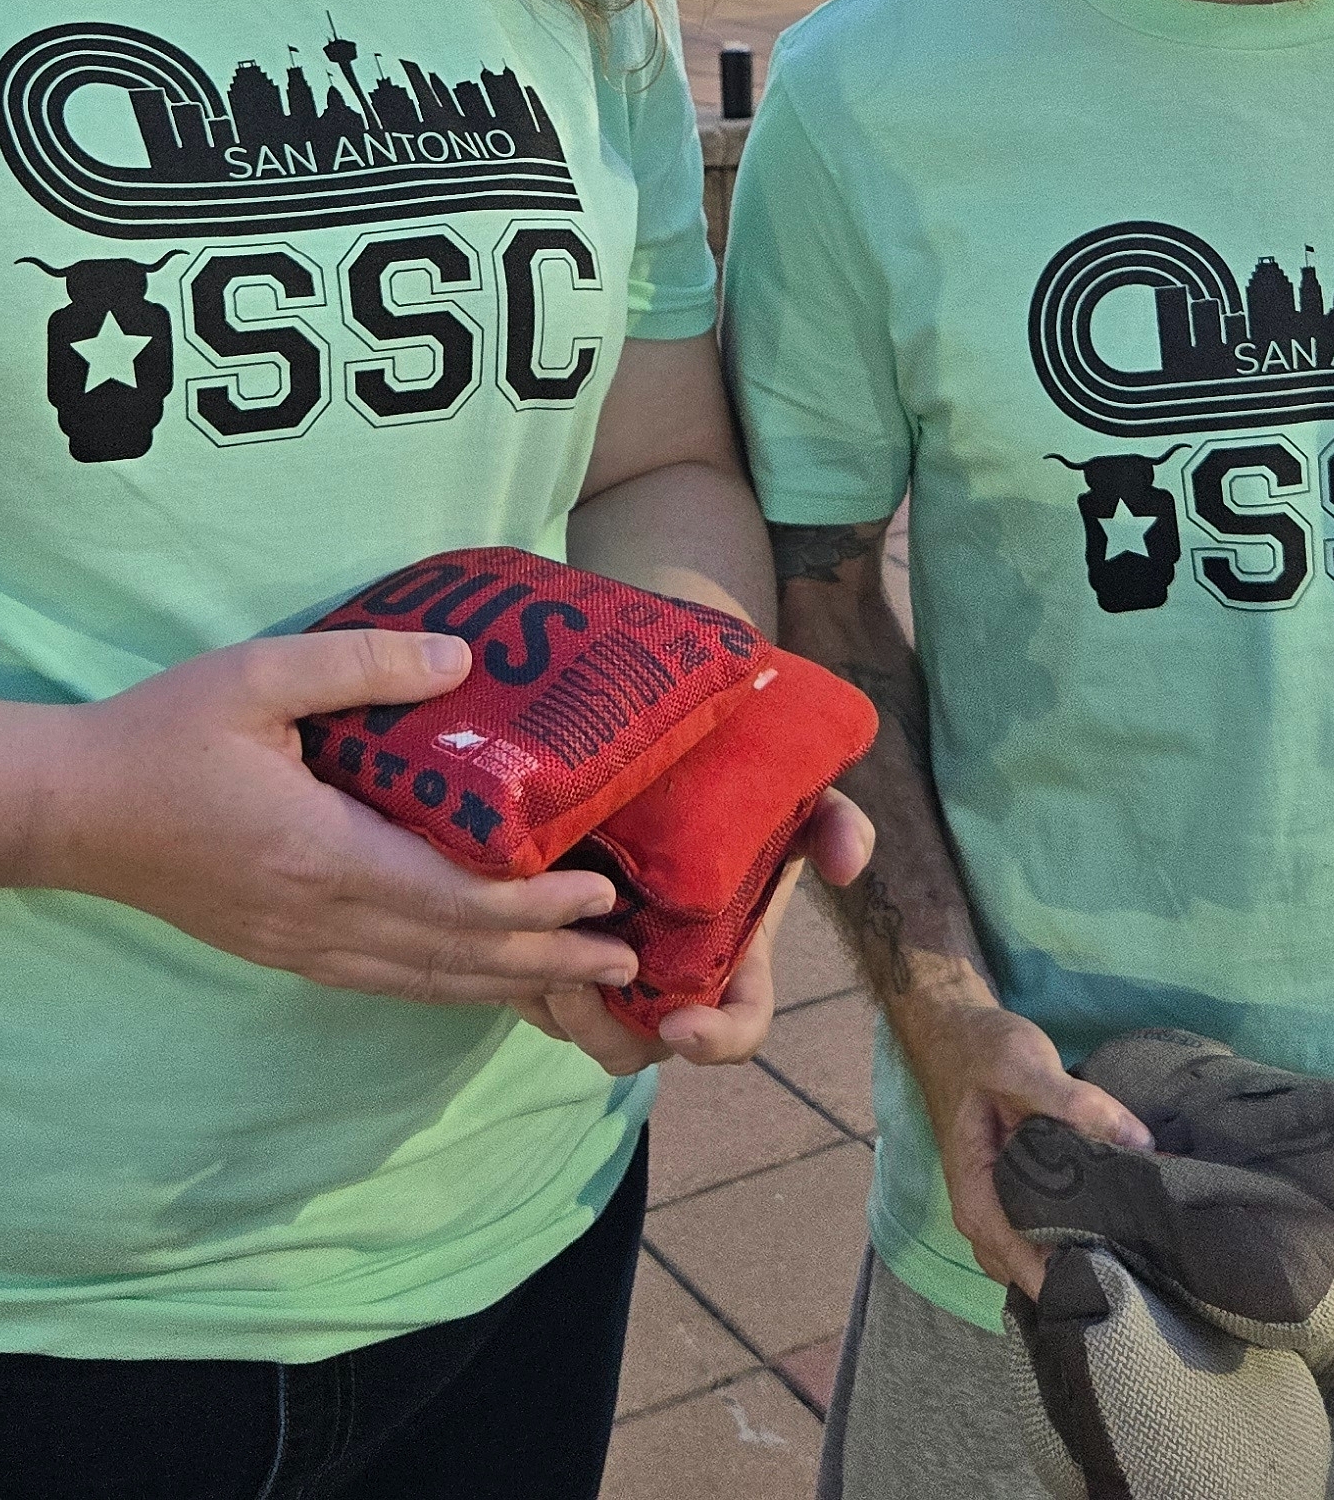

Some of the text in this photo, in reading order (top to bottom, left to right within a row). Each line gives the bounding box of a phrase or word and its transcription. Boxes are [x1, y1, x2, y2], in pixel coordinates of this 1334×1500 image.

[224, 128, 517, 179] SAN ANTONIO
[179, 218, 603, 448] SSC
[1233, 335, 1318, 375] SAN
[301, 712, 506, 846] STON
